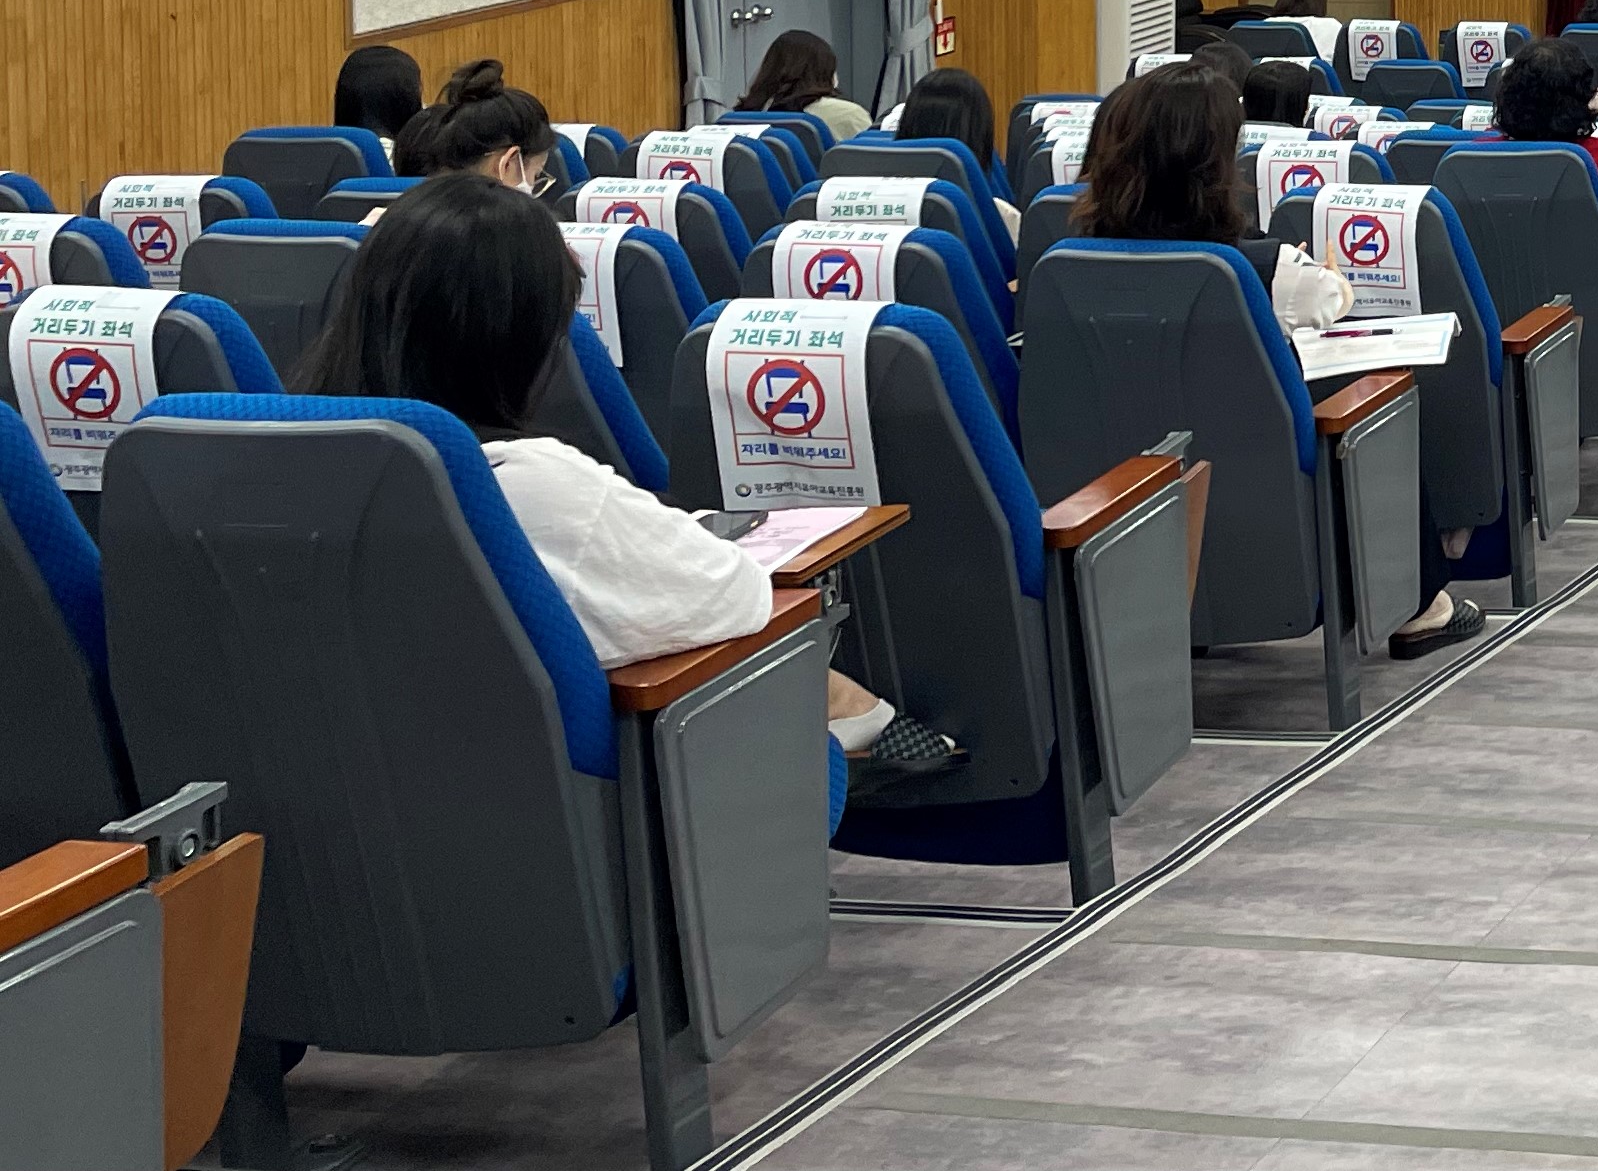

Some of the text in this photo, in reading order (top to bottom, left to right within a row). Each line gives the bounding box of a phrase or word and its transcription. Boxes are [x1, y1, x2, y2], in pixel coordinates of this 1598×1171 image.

[112, 197, 158, 208] 거리두기
[831, 205, 877, 216] 거리두기
[741, 310, 798, 323] 사회적
[29, 318, 134, 338] 거리두기 좌석
[728, 329, 844, 348] 거리두기 좌석
[741, 443, 779, 456] 자리를
